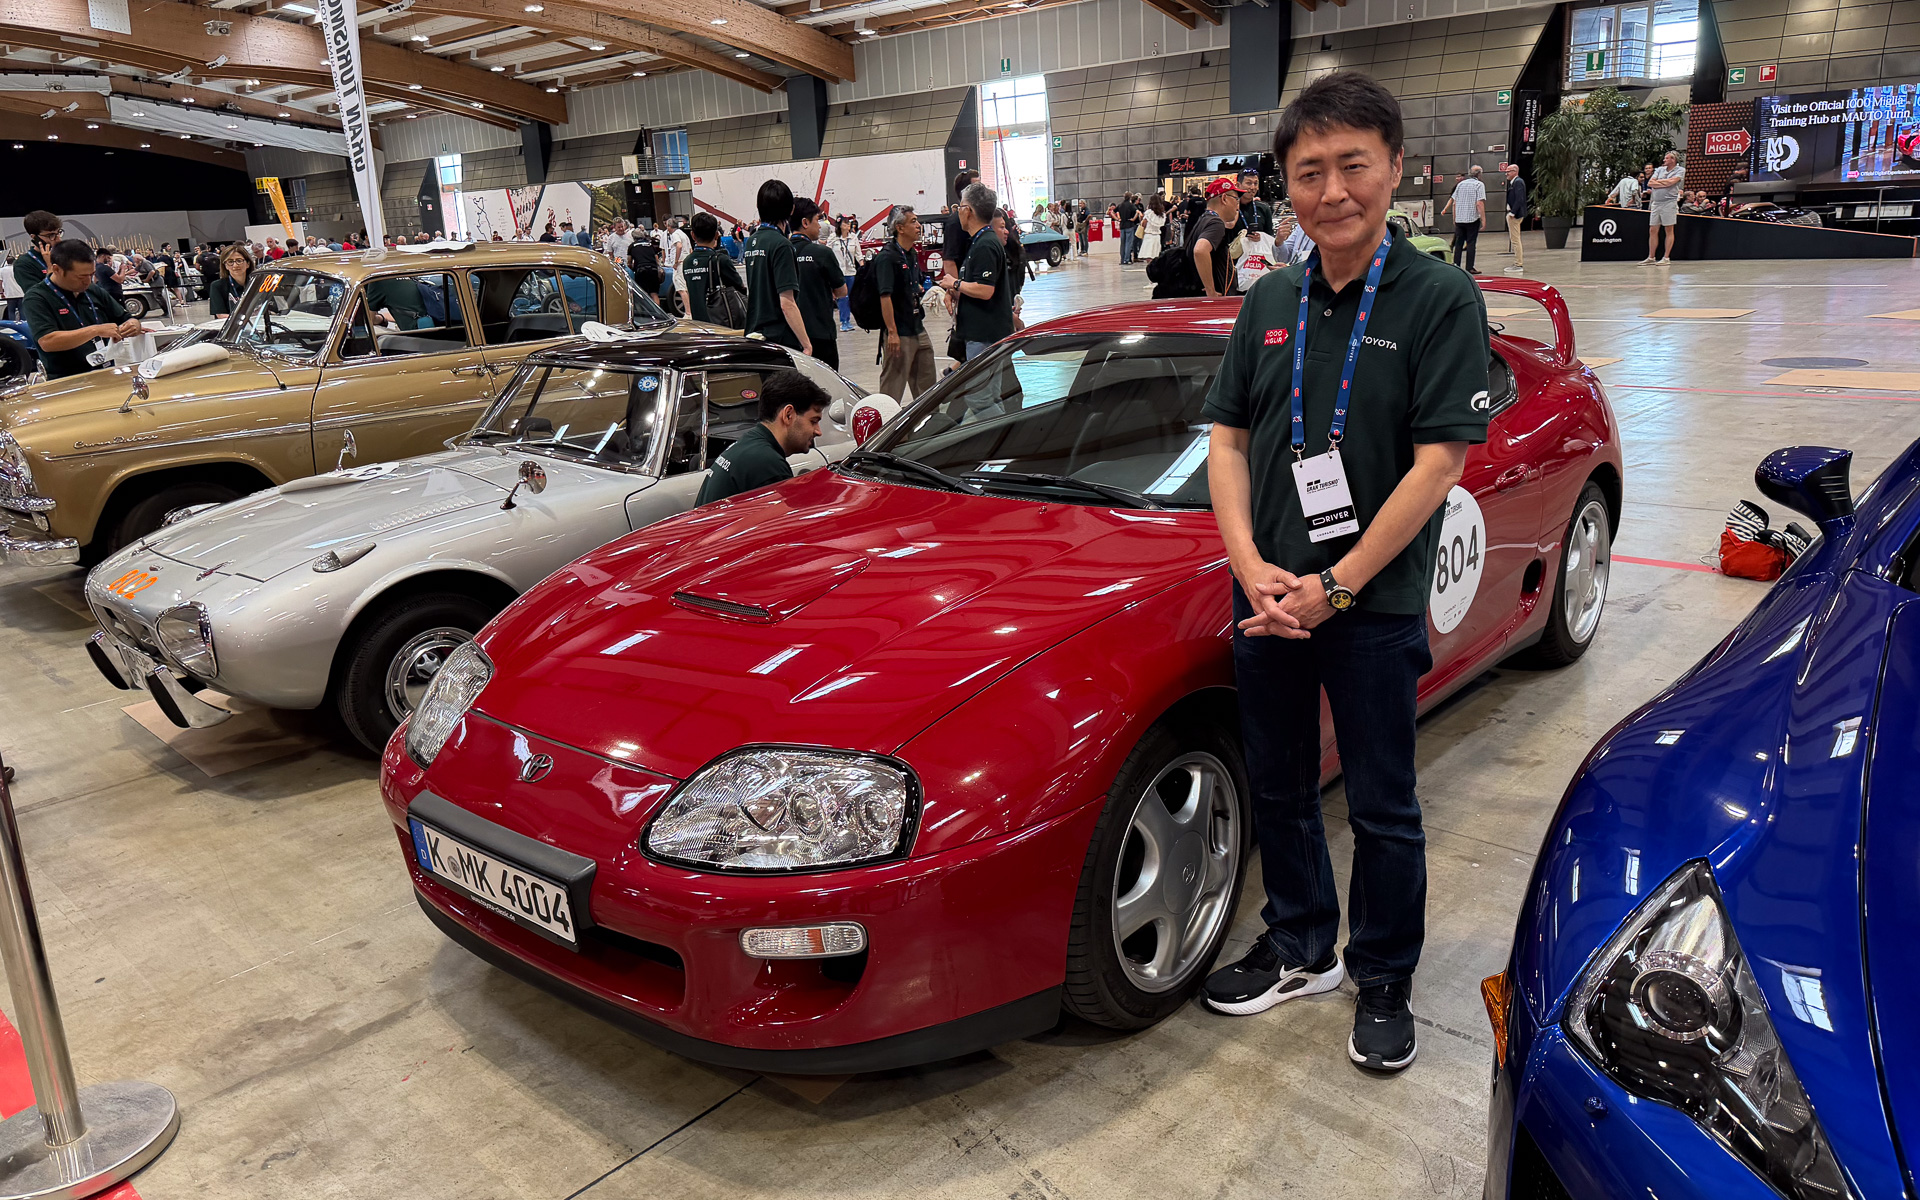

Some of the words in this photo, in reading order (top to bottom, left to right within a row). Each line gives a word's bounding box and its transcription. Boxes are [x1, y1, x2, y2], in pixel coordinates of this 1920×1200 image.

[1524, 99, 1532, 125] Digital
[1771, 103, 1791, 114] Visit
[1793, 102, 1807, 113] the
[1809, 100, 1844, 112] Official
[1846, 98, 1870, 109] 1000
[1872, 95, 1904, 108] Miglia
[1529, 99, 1537, 142] Experience
[1769, 115, 1807, 128] Training
[1808, 112, 1830, 125] Hub
[1831, 113, 1841, 123] at
[1842, 110, 1882, 122] MAUTO
[1885, 108, 1910, 120] Turin
[1711, 133, 1741, 142] 1000
[1708, 143, 1742, 153] MIGLIA
[932, 260, 939, 268] 12
[1361, 335, 1398, 351] TOYOTA
[1312, 510, 1350, 526] DRIVER
[1437, 524, 1479, 595] 804
[420, 848, 427, 860] D
[426, 831, 447, 874] K
[456, 846, 497, 898] MK
[500, 869, 570, 934] 4004
